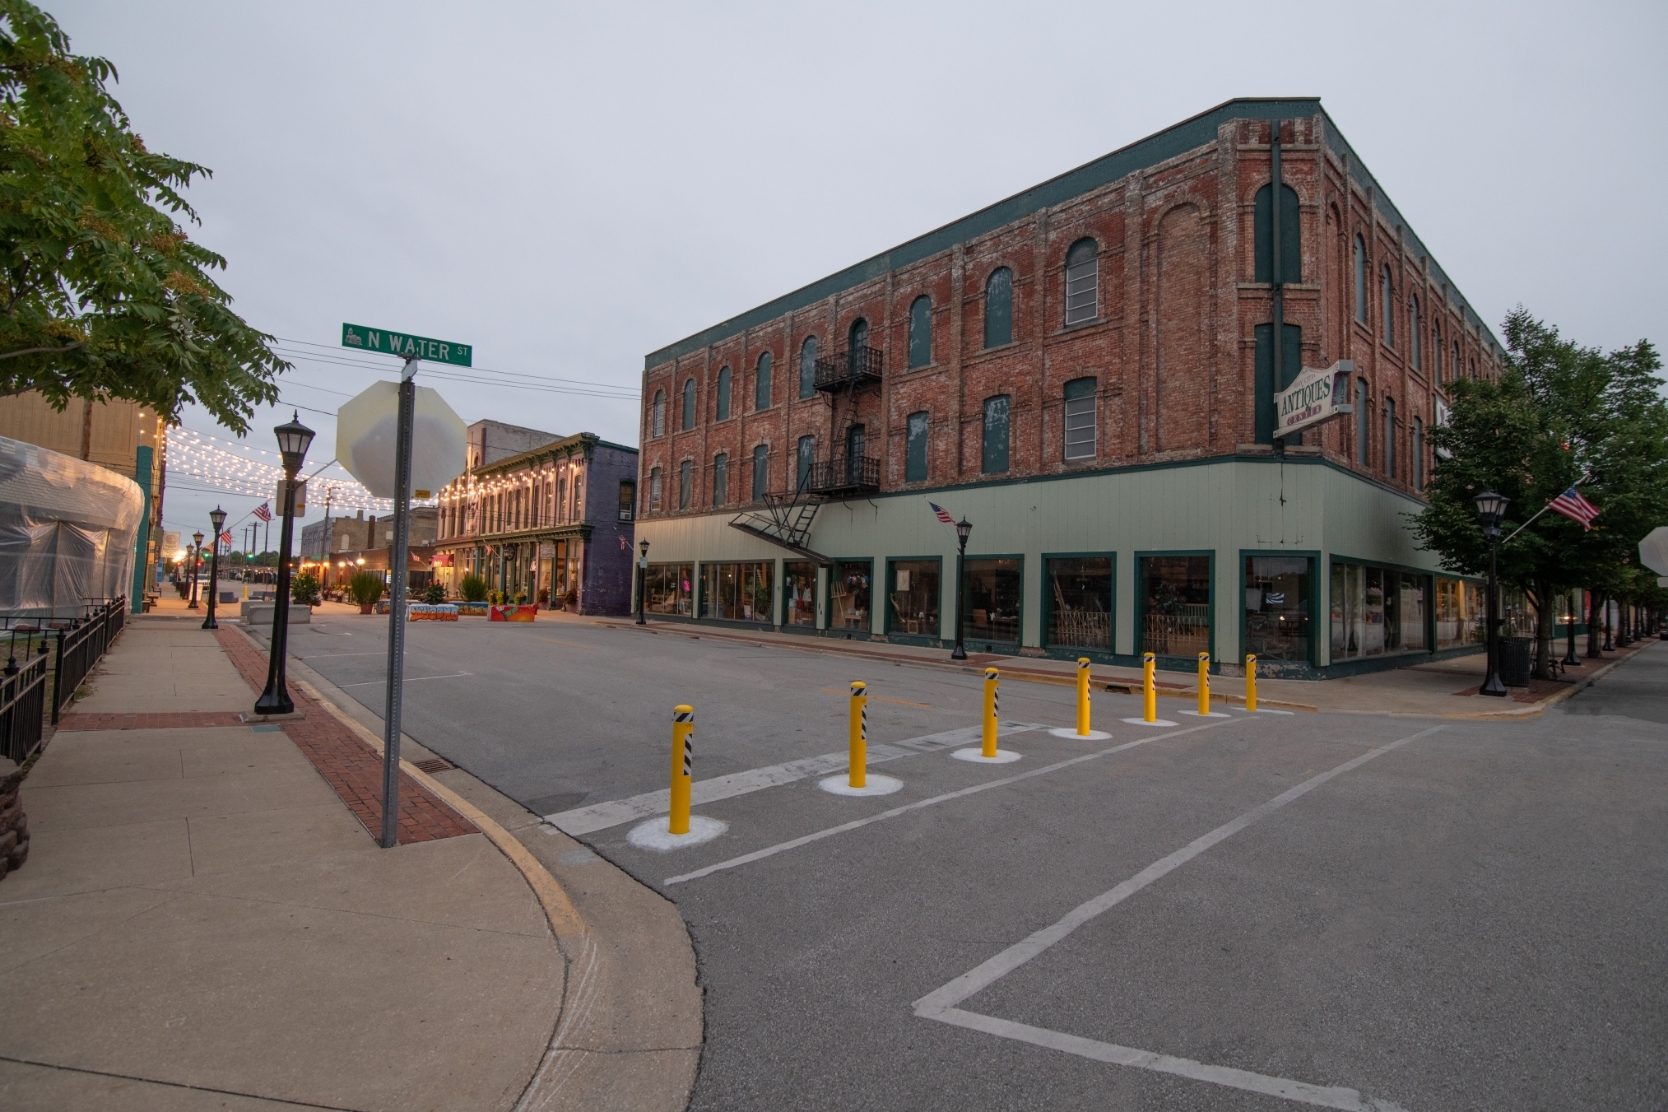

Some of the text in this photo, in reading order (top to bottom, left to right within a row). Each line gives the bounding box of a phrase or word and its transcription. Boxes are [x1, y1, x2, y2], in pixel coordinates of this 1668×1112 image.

[368, 331, 468, 360] N WATER ST
[1281, 374, 1331, 416] ANTIQUES
[1288, 407, 1321, 425] CENTER
